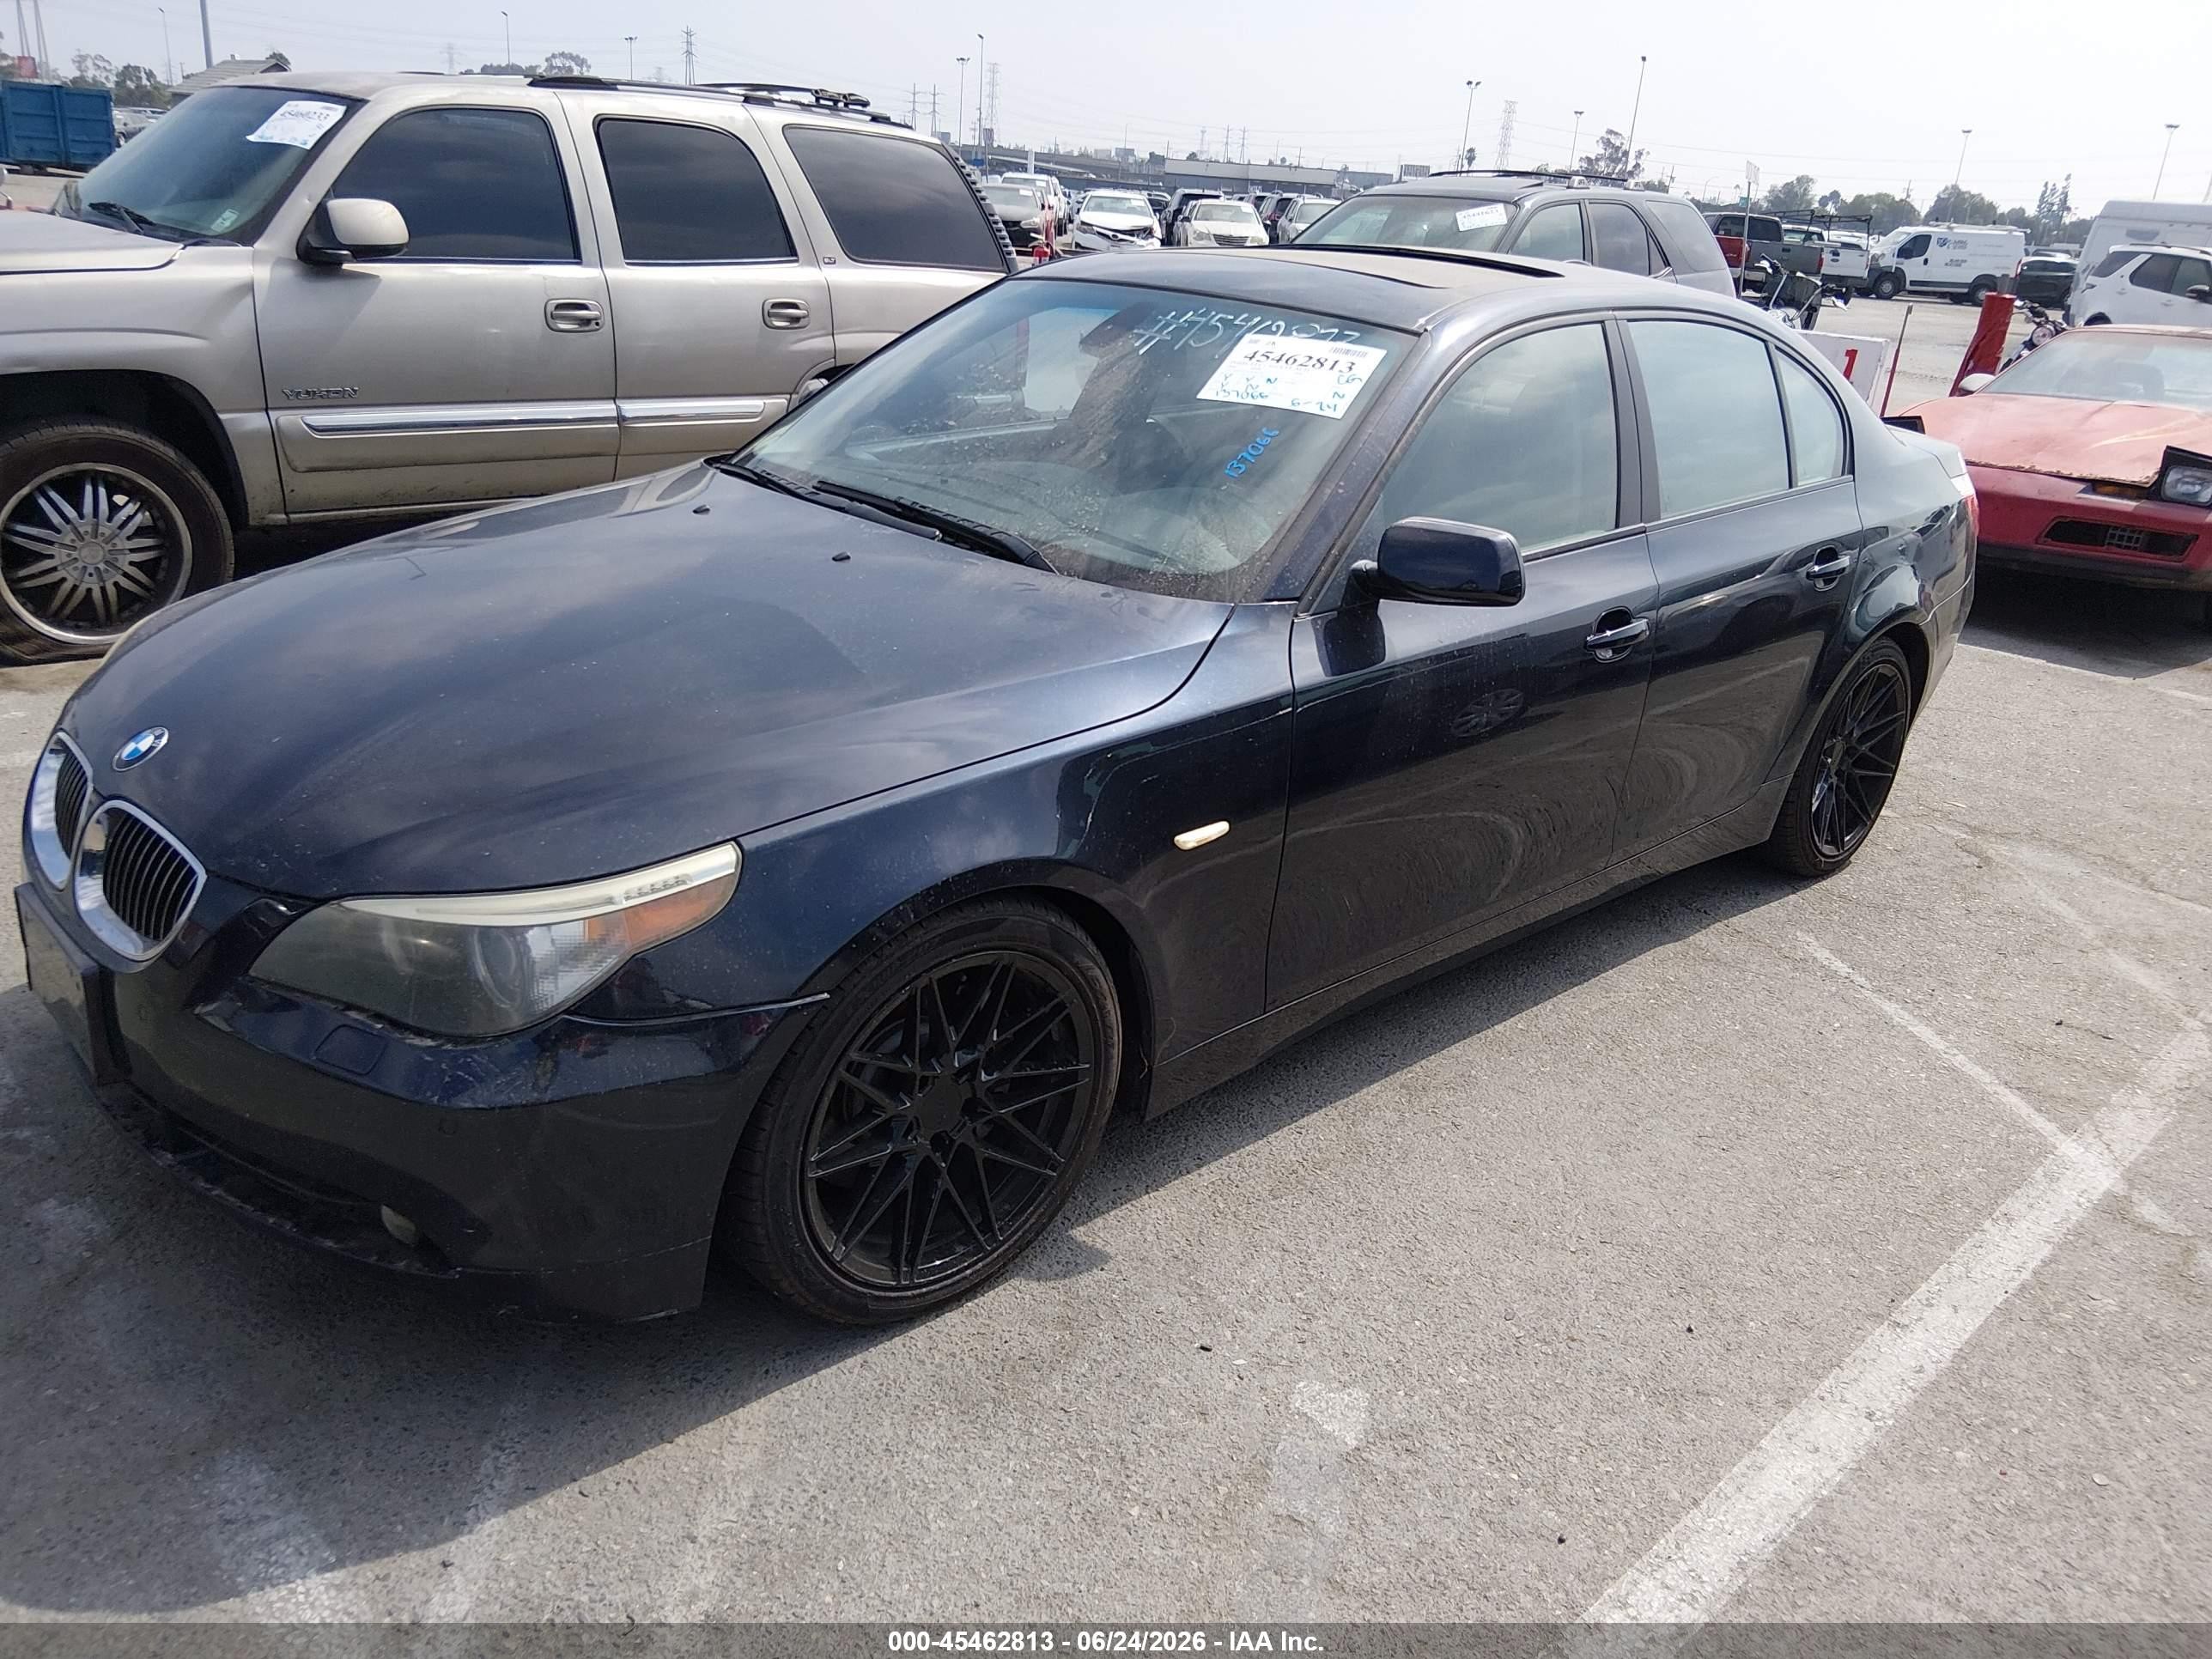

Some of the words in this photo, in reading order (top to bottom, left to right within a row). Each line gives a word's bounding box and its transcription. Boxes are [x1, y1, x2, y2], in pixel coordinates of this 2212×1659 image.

[1243, 349, 1357, 374] 45462813
[282, 386, 359, 399] YUKON
[1224, 427, 1279, 477] 137066
